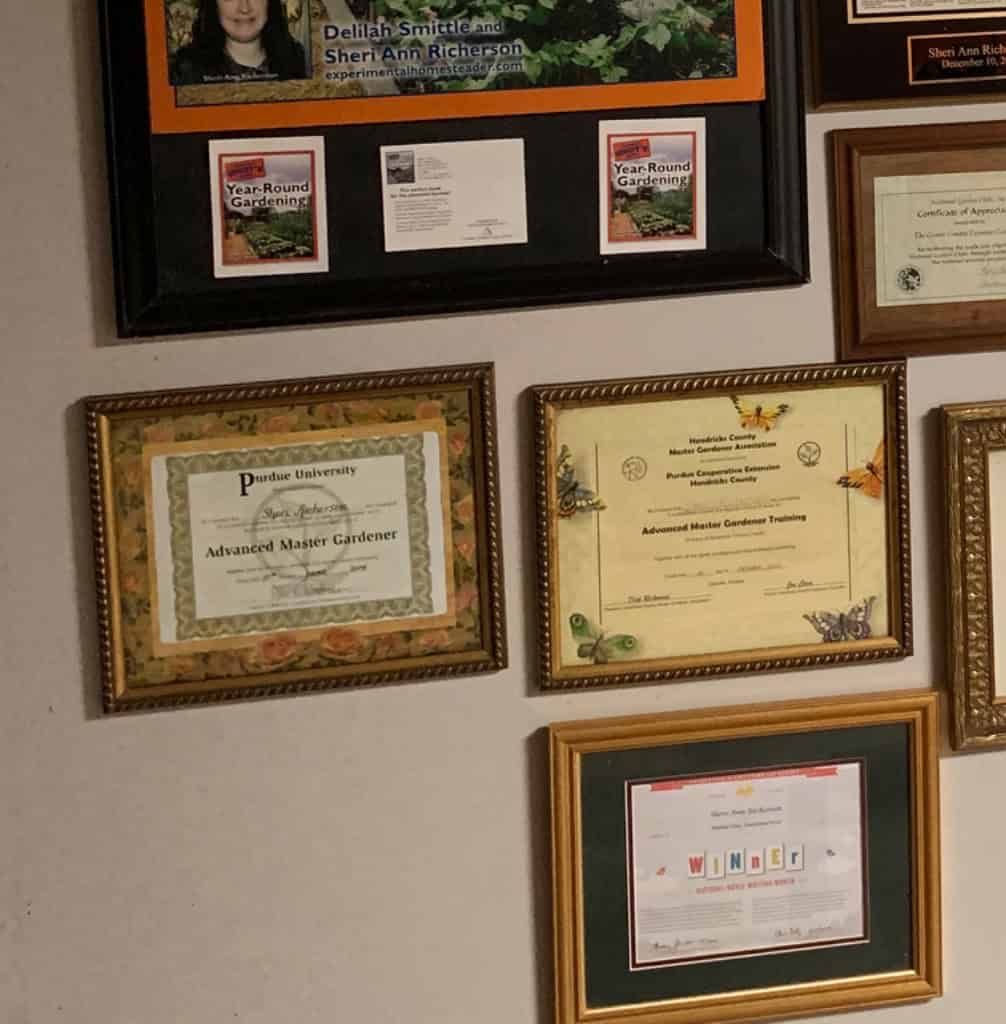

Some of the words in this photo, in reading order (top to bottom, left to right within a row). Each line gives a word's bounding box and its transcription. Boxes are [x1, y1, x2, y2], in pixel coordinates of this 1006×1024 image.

[323, 23, 393, 41] Delilah
[398, 19, 471, 38] Smittle
[476, 21, 502, 34] and
[324, 46, 376, 65] Sheri
[381, 45, 422, 62] Ann
[427, 40, 522, 59] Richerson
[928, 46, 956, 58] Sheri
[958, 45, 979, 57] Ann
[325, 60, 523, 82] experimentalhomesteader.com
[941, 58, 984, 70] December
[614, 161, 690, 174] Year-Round
[226, 181, 309, 195] Year-Round
[618, 174, 688, 186] Gardening
[231, 196, 307, 208] Gardening
[239, 471, 291, 496] Purdue
[295, 465, 357, 481] University
[642, 523, 689, 536] Advanced
[691, 520, 721, 530] Master
[724, 517, 767, 528] Gardener
[769, 514, 807, 526] Training
[205, 541, 274, 559] Advanced
[280, 537, 327, 552] Master
[332, 529, 398, 546] Gardener
